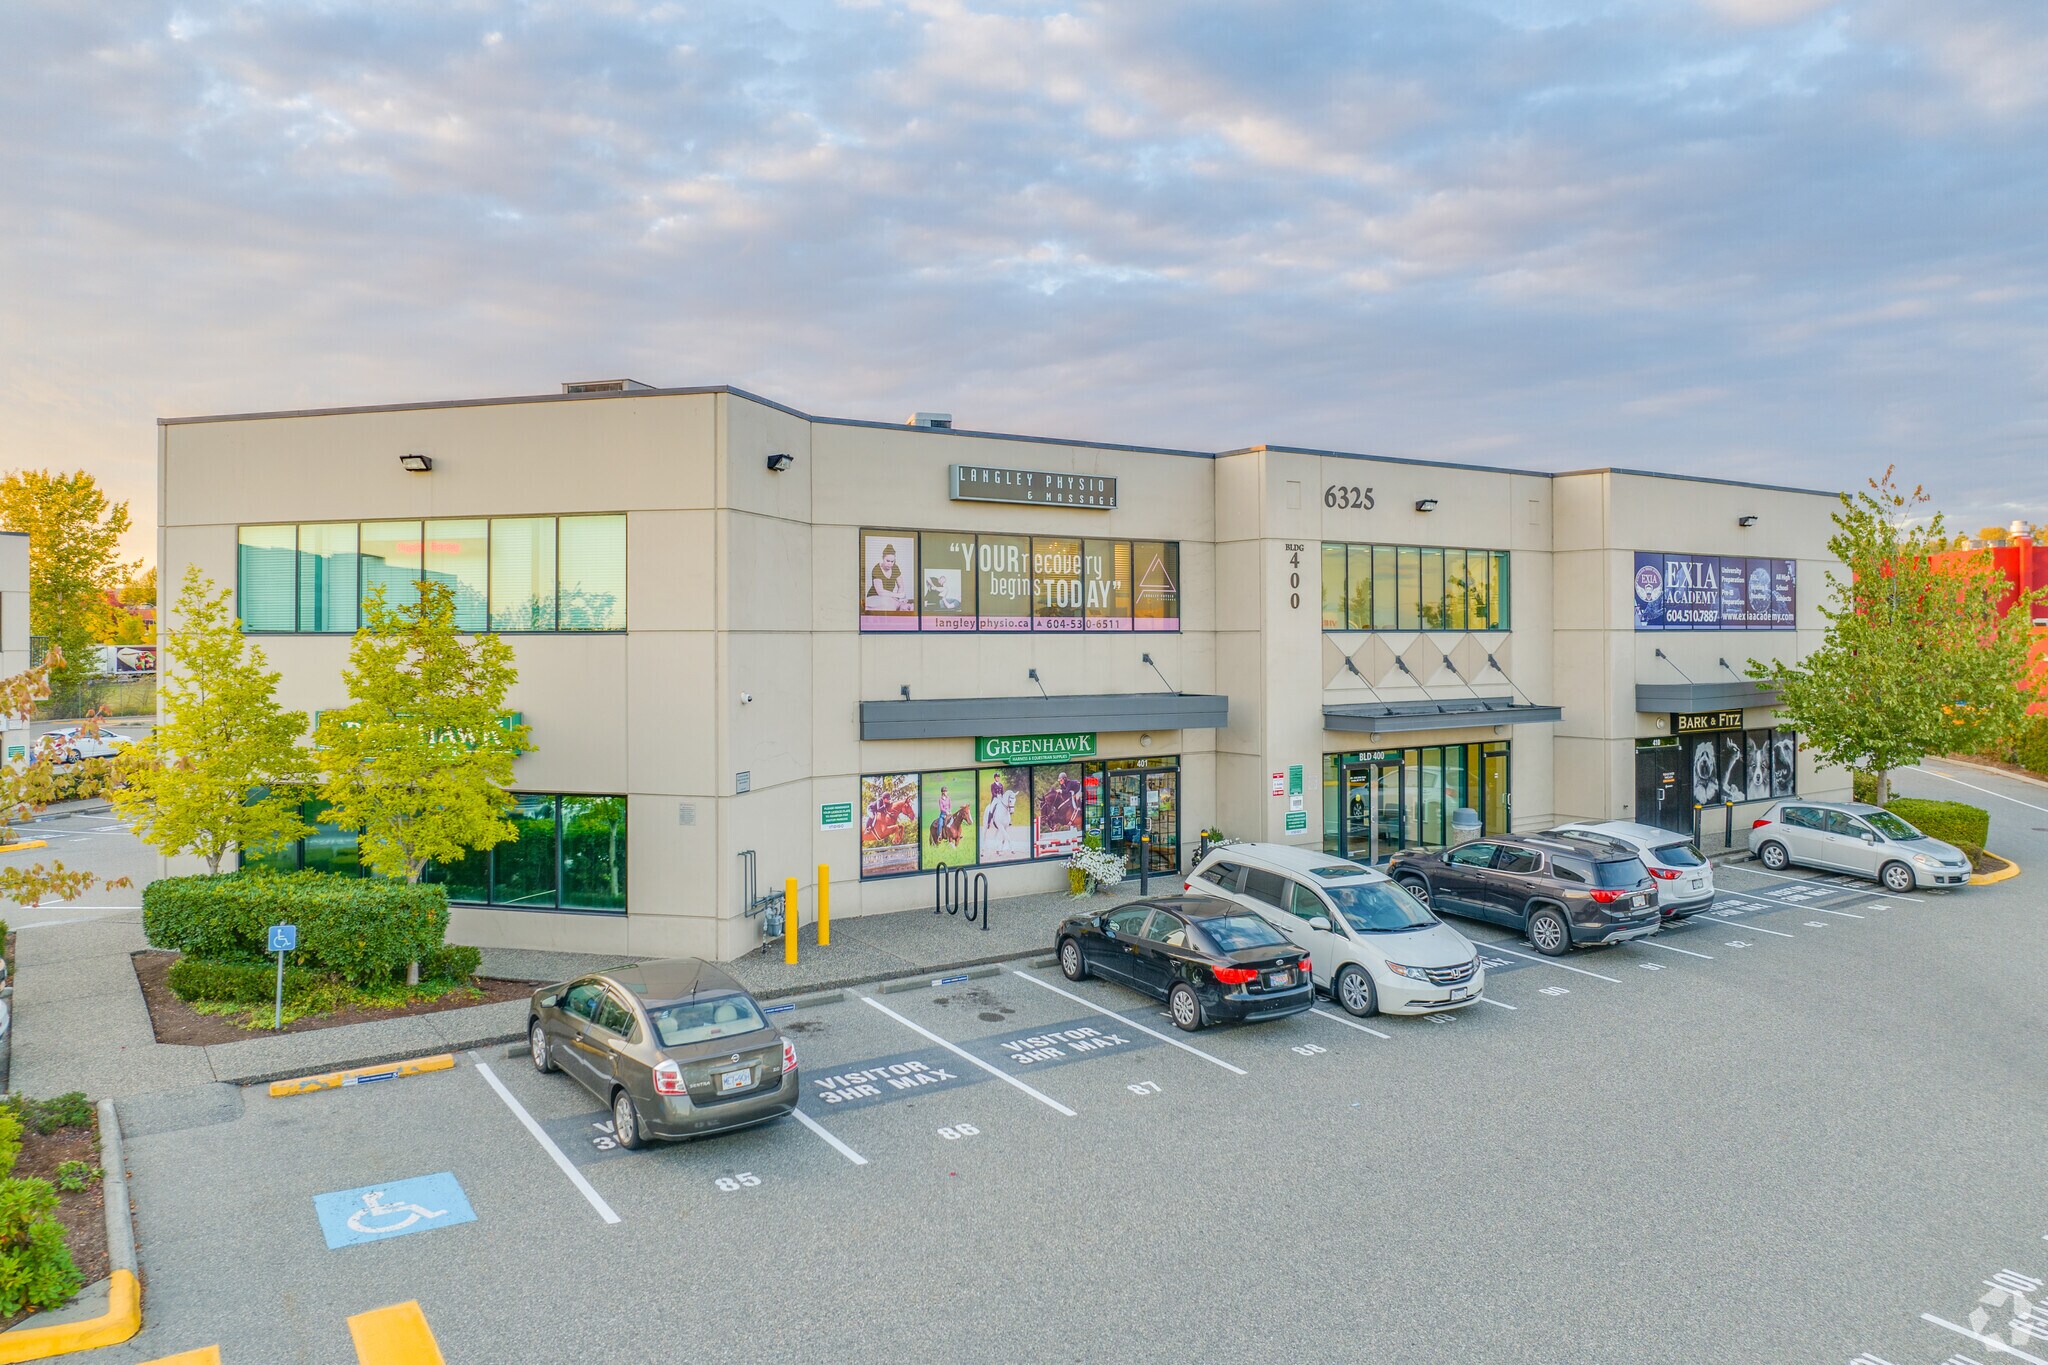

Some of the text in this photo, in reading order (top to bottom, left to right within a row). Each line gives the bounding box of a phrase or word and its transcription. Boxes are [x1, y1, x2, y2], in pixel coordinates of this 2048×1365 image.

[960, 467, 1104, 492] LANGLEY PHYSIO
[1027, 490, 1114, 506] & MASSAGE
[1324, 485, 1375, 510] 6325
[1285, 543, 1304, 551] BLDG
[1022, 553, 1102, 580] recovery
[1721, 566, 1742, 575] University
[1641, 574, 1658, 584] EXIA
[1666, 561, 1718, 589] EXIA
[990, 572, 1041, 600] begins
[1666, 590, 1718, 605] ACADEMY
[1666, 609, 1718, 622] 604.510.7887
[1721, 611, 1794, 623] www.exiaacademy.com
[1679, 713, 1741, 729] BARK & FITZ
[986, 735, 1092, 757] GREENHAWK
[1359, 751, 1385, 761] BLD 400
[1639, 962, 1667, 971] 91
[1538, 986, 1570, 996] 90
[1423, 1013, 1457, 1024] 89
[1001, 1026, 1102, 1051] VISITOR
[1010, 1034, 1130, 1064] 3HR MAX
[1291, 1043, 1327, 1056] 88
[814, 1060, 930, 1090] VISITOR
[819, 1068, 957, 1104] 3HR MAX
[1127, 1080, 1162, 1095] 87
[936, 1122, 980, 1141] 86
[714, 1171, 762, 1191] 85
